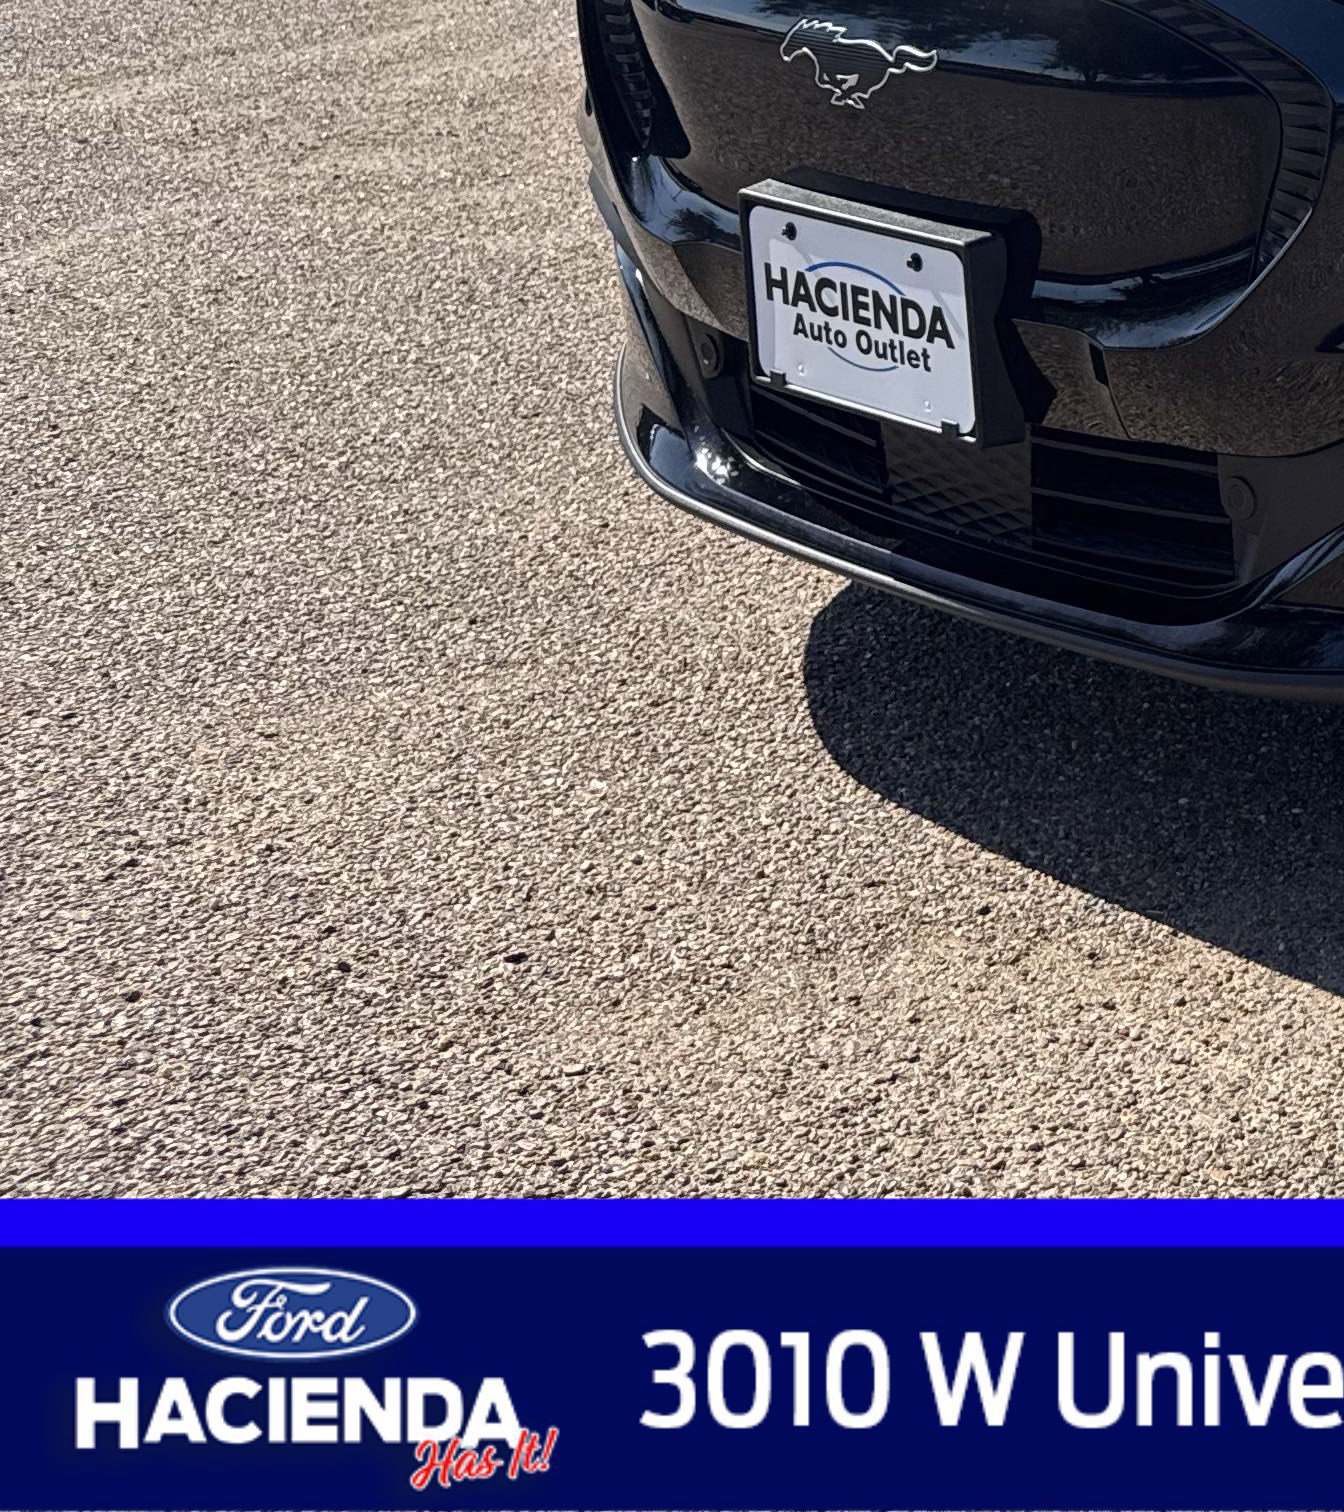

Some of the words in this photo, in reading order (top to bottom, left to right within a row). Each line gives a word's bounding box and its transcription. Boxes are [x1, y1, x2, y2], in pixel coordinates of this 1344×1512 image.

[764, 262, 956, 350] HACIENDA
[793, 313, 848, 349] Auto
[856, 329, 932, 372] Outlet
